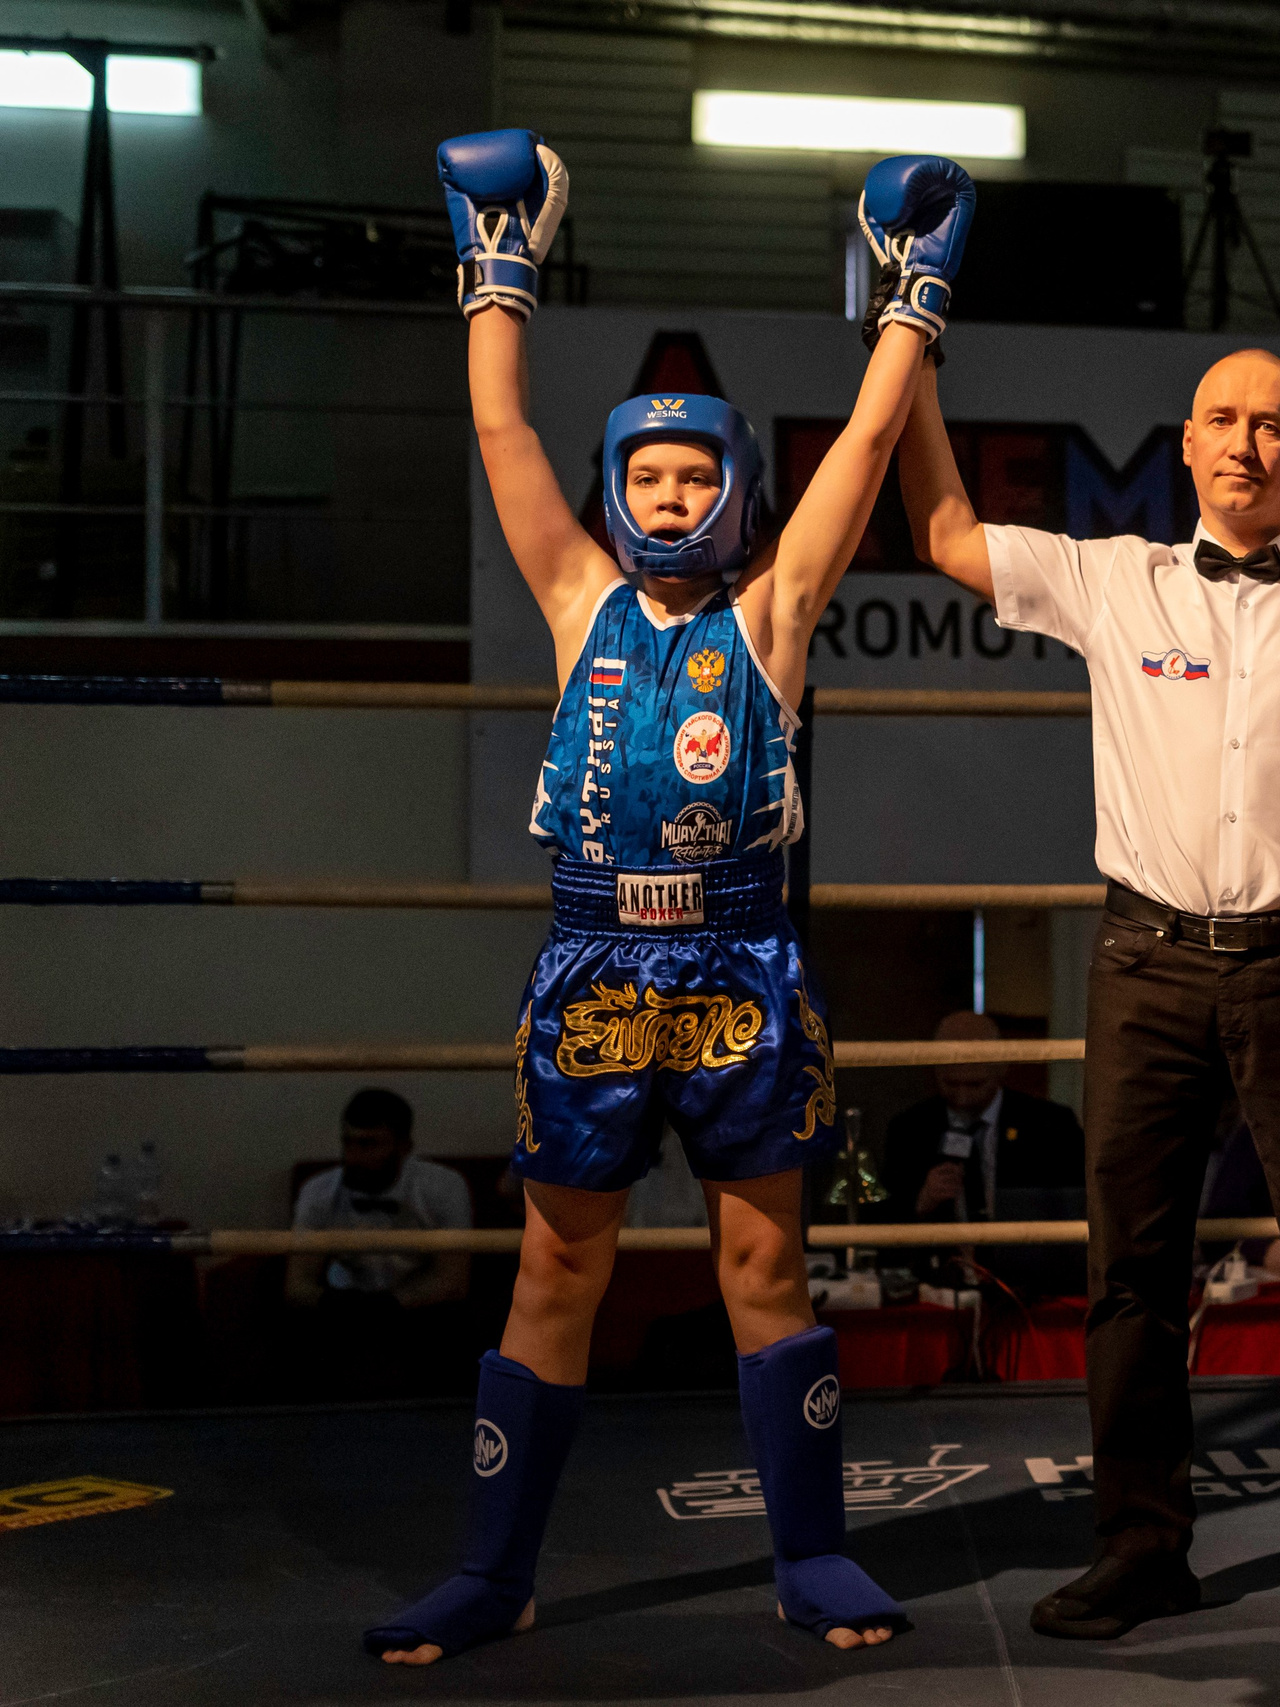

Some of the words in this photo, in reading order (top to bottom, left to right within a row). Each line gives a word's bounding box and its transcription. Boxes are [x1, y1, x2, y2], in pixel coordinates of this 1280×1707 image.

[647, 410, 687, 419] WESING
[601, 698, 620, 824] RUSSIA
[661, 820, 698, 849] MUAY
[704, 819, 733, 845] THAI
[619, 882, 702, 912] ANOTHER
[640, 907, 684, 921] BOXER
